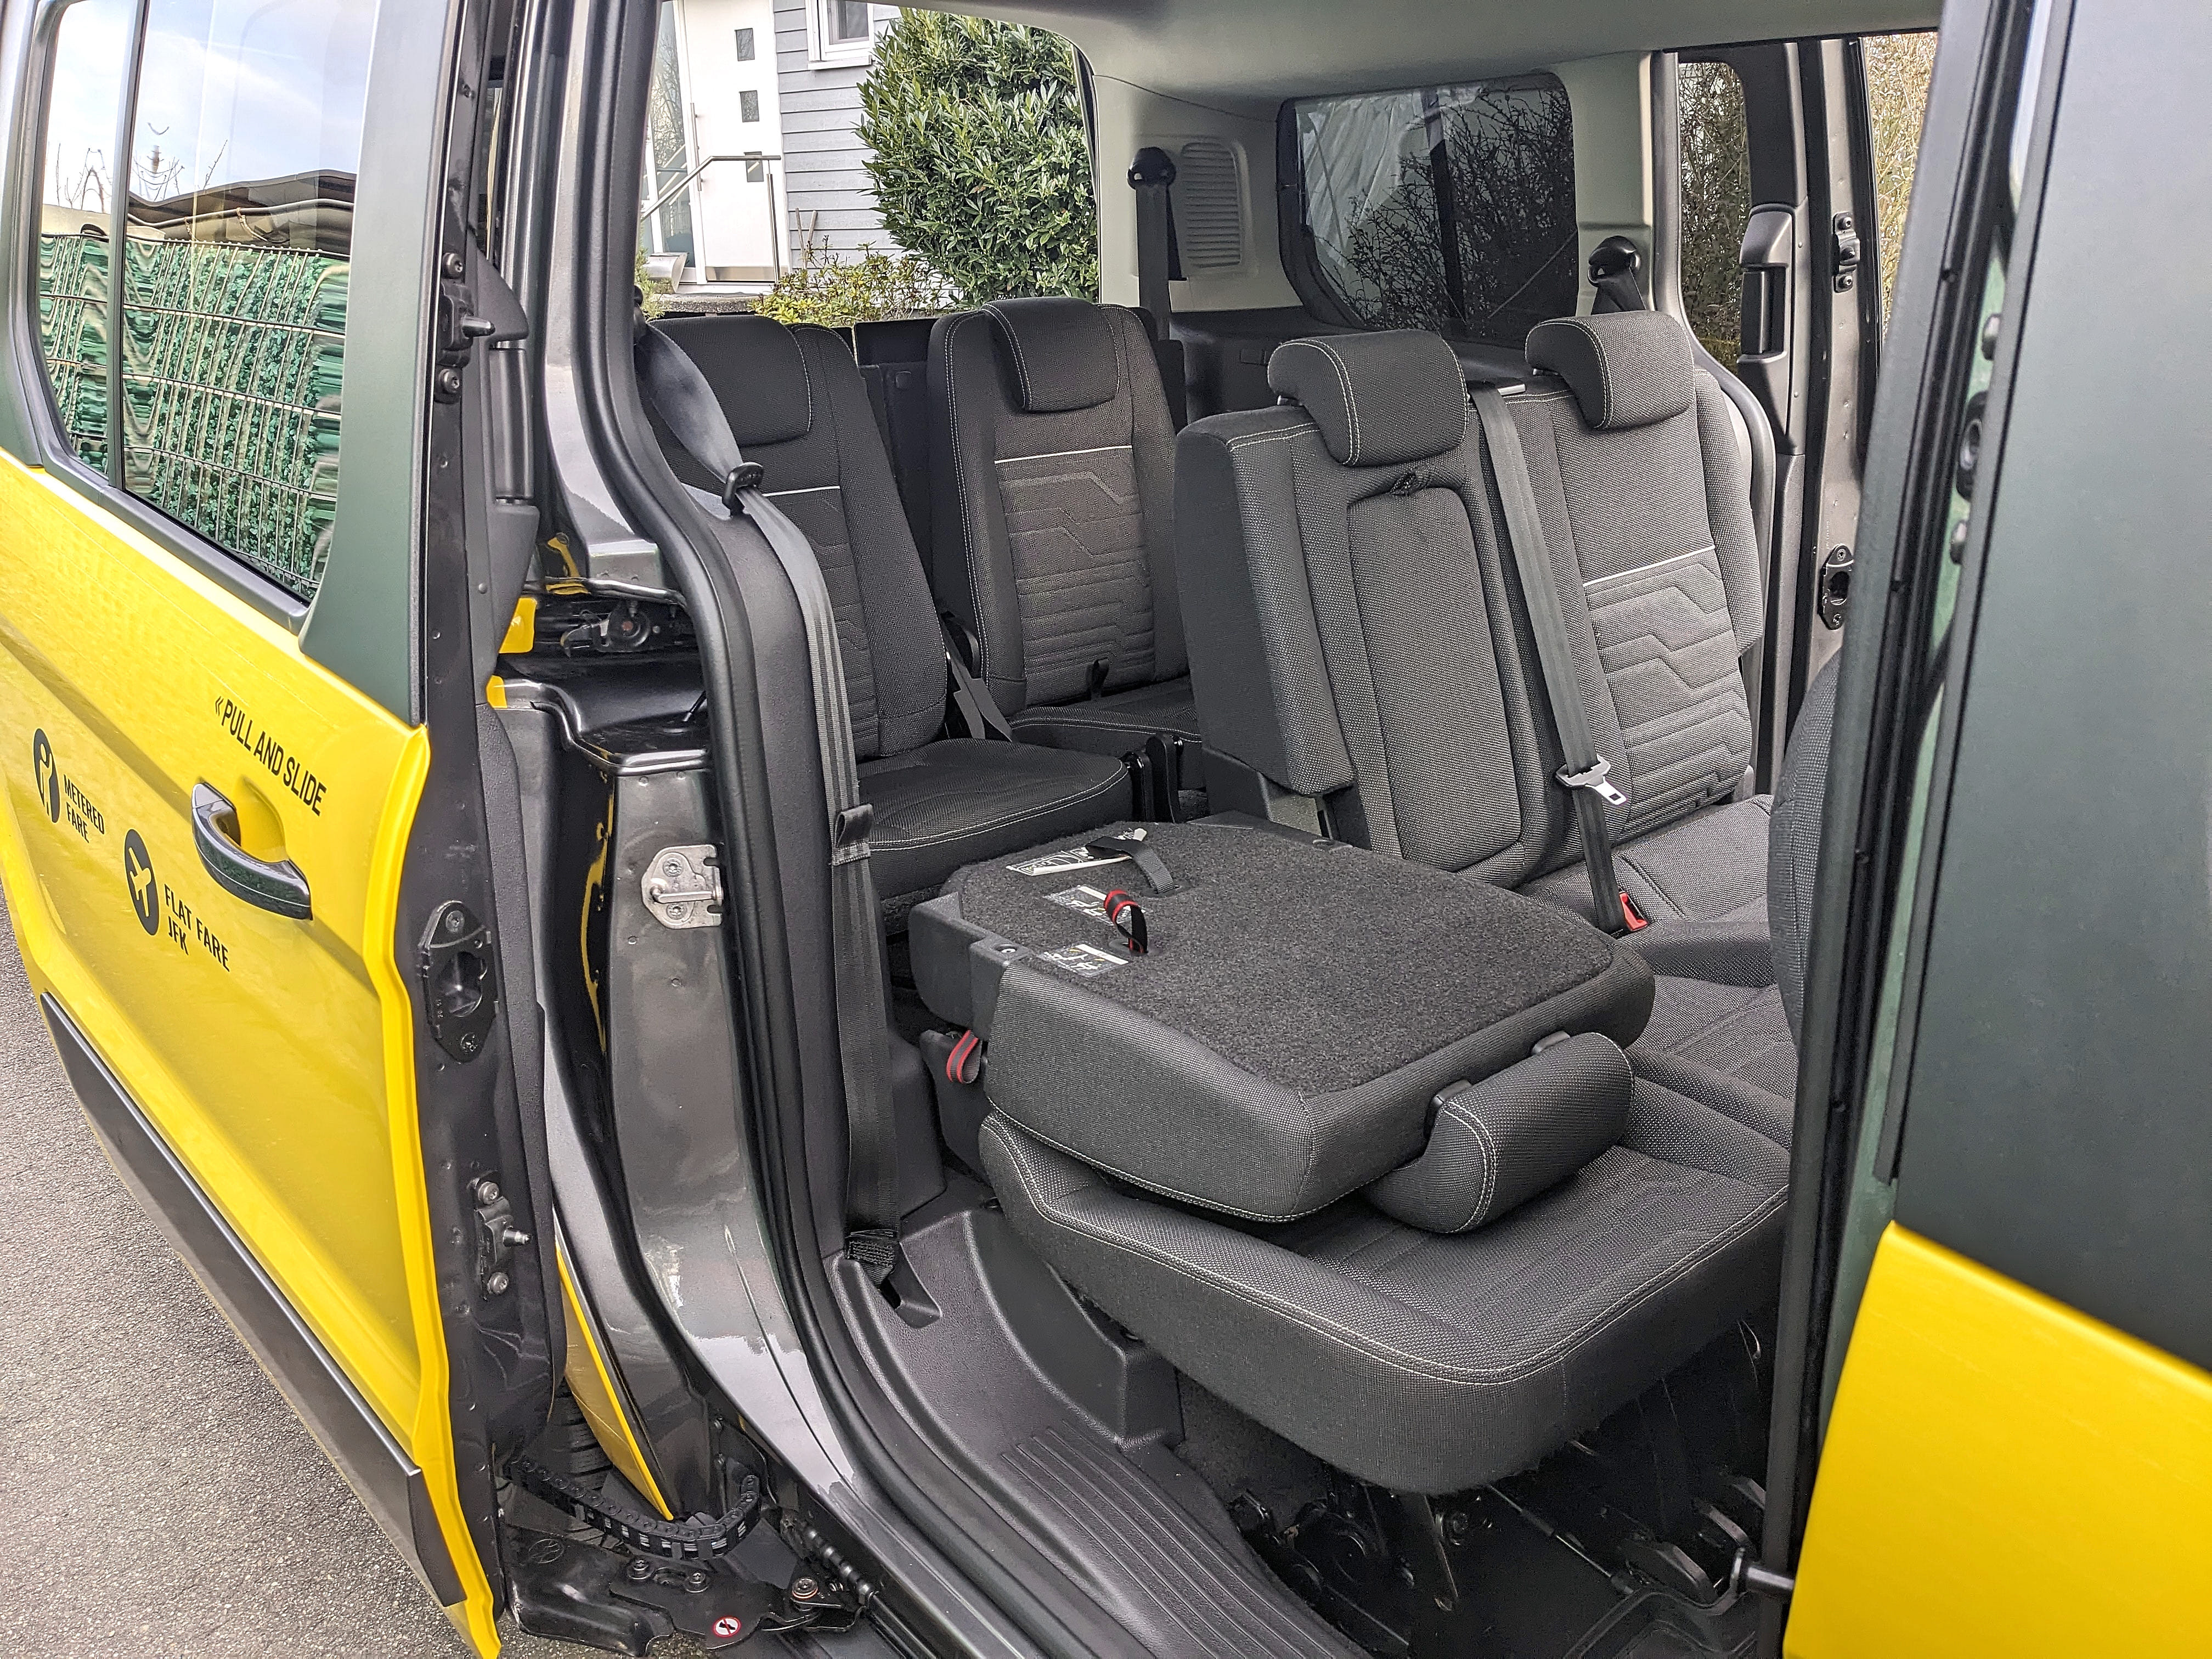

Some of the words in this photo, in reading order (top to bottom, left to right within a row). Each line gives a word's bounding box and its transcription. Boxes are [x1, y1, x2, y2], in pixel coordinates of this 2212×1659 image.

[221, 698, 253, 752] PULL
[253, 730, 284, 776] AND
[283, 757, 328, 817] SLIDE
[64, 774, 105, 834] METERED
[66, 802, 89, 843] FARE
[165, 883, 192, 930] FLAT
[196, 917, 230, 972] FARE
[168, 916, 189, 956] JFK
